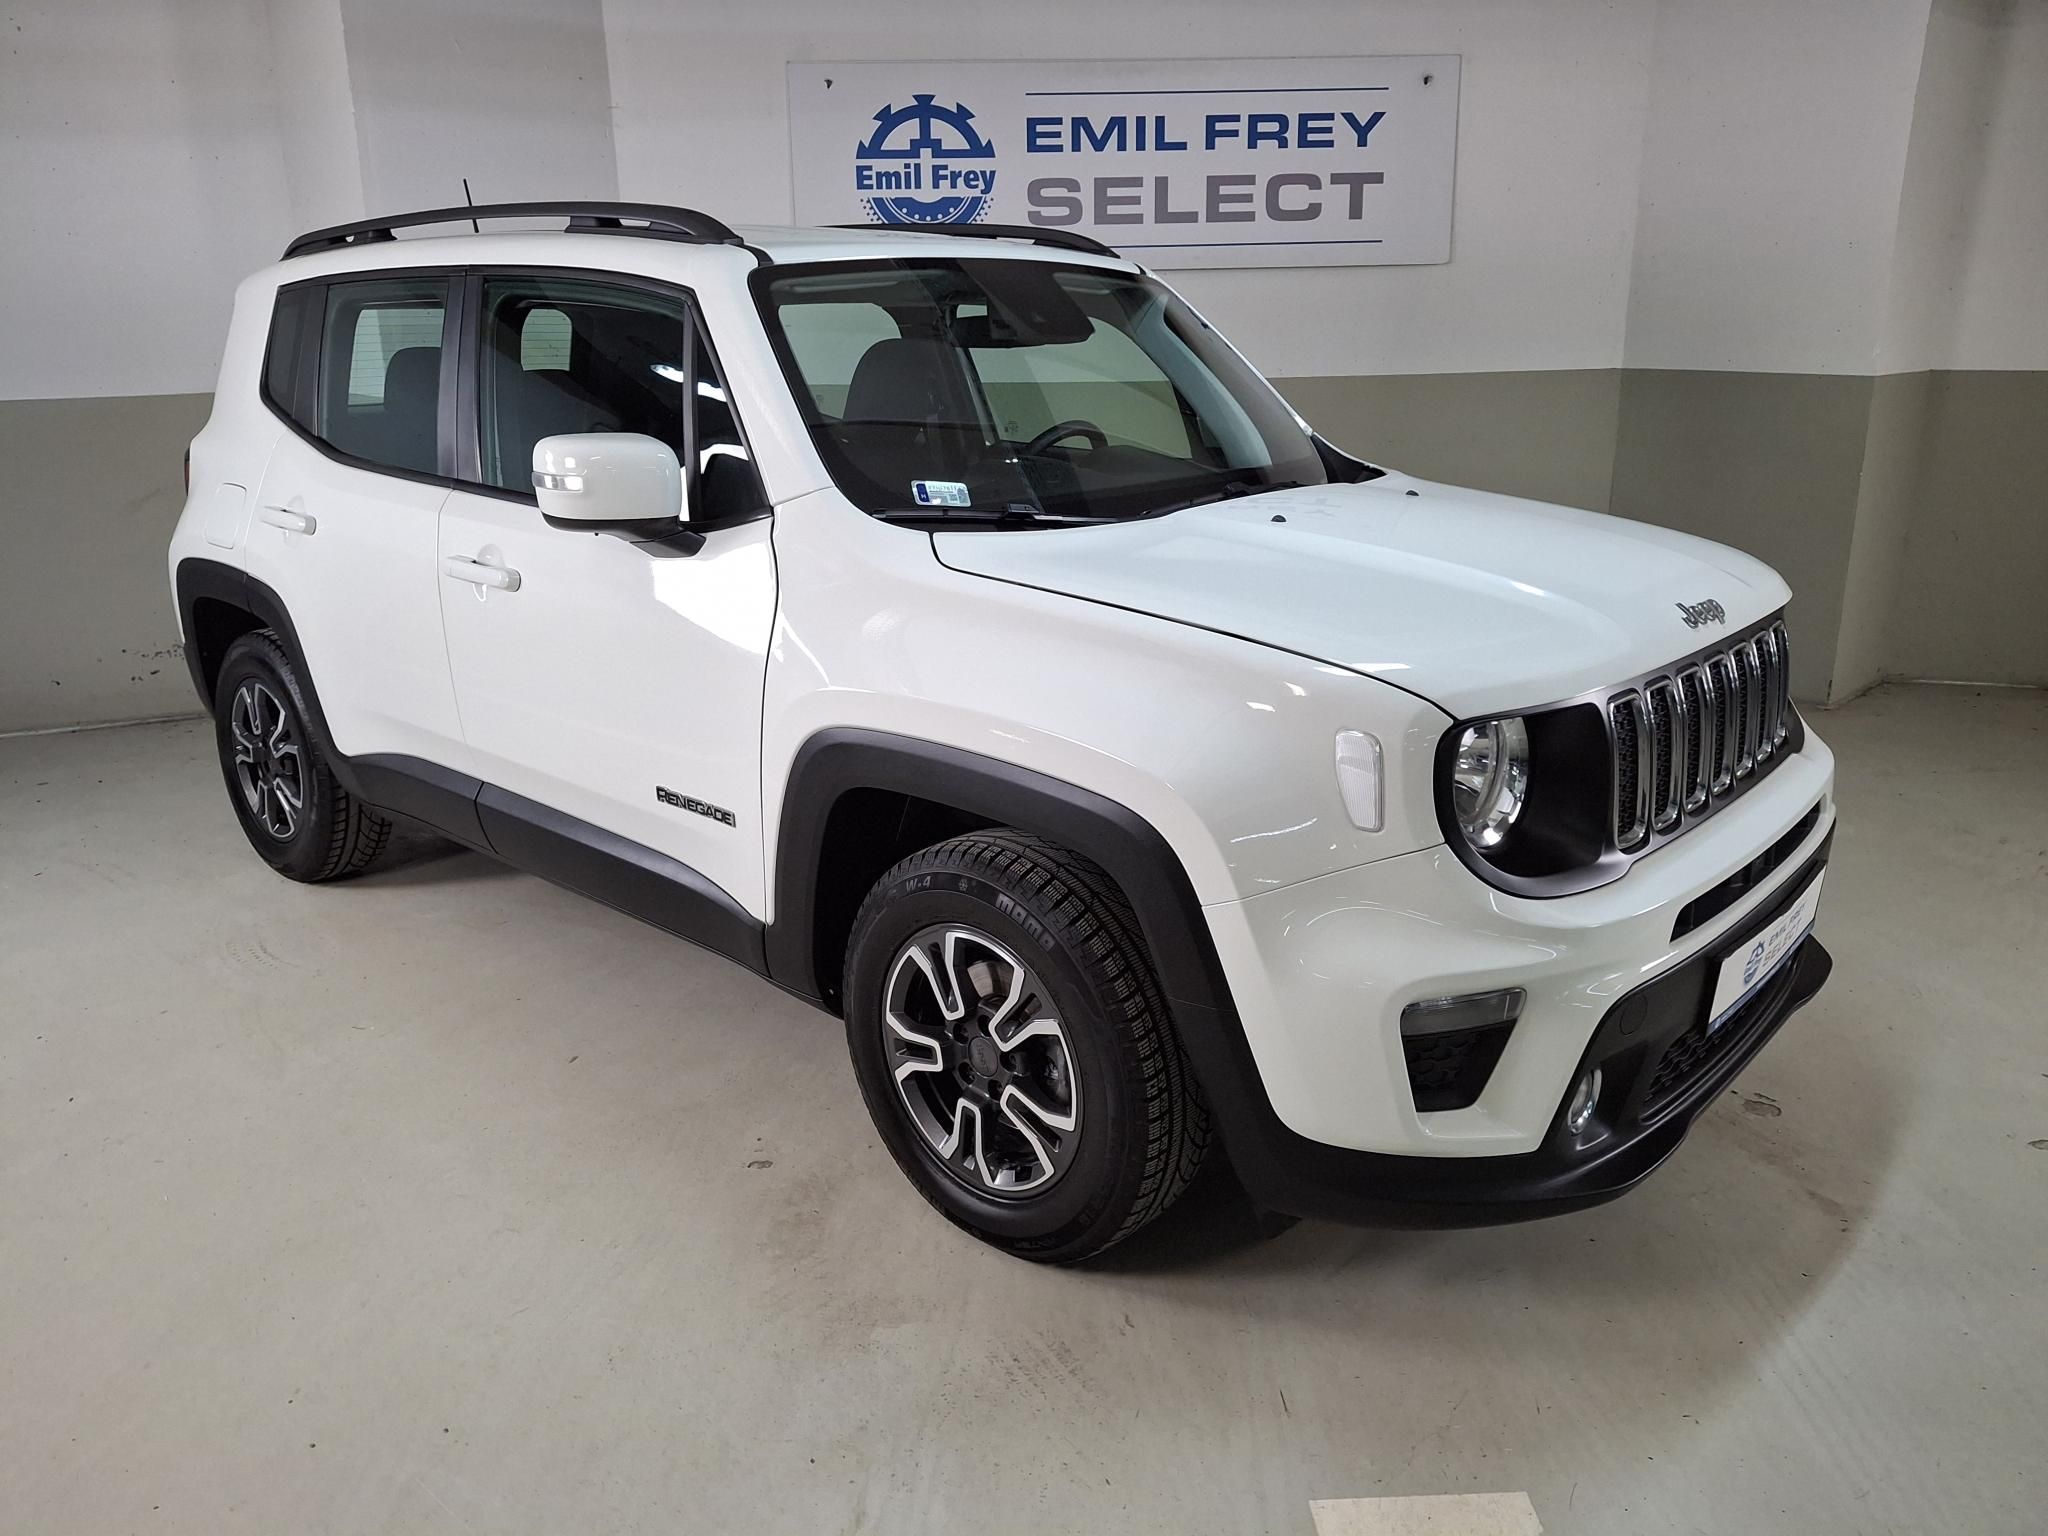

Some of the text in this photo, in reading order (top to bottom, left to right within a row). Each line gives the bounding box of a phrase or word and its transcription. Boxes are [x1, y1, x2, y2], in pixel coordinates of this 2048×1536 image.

[1026, 112, 1386, 153] EMIL FREY
[856, 163, 996, 195] Emil Frey
[1027, 172, 1384, 226] SELECT
[656, 786, 736, 828] RENEGADE
